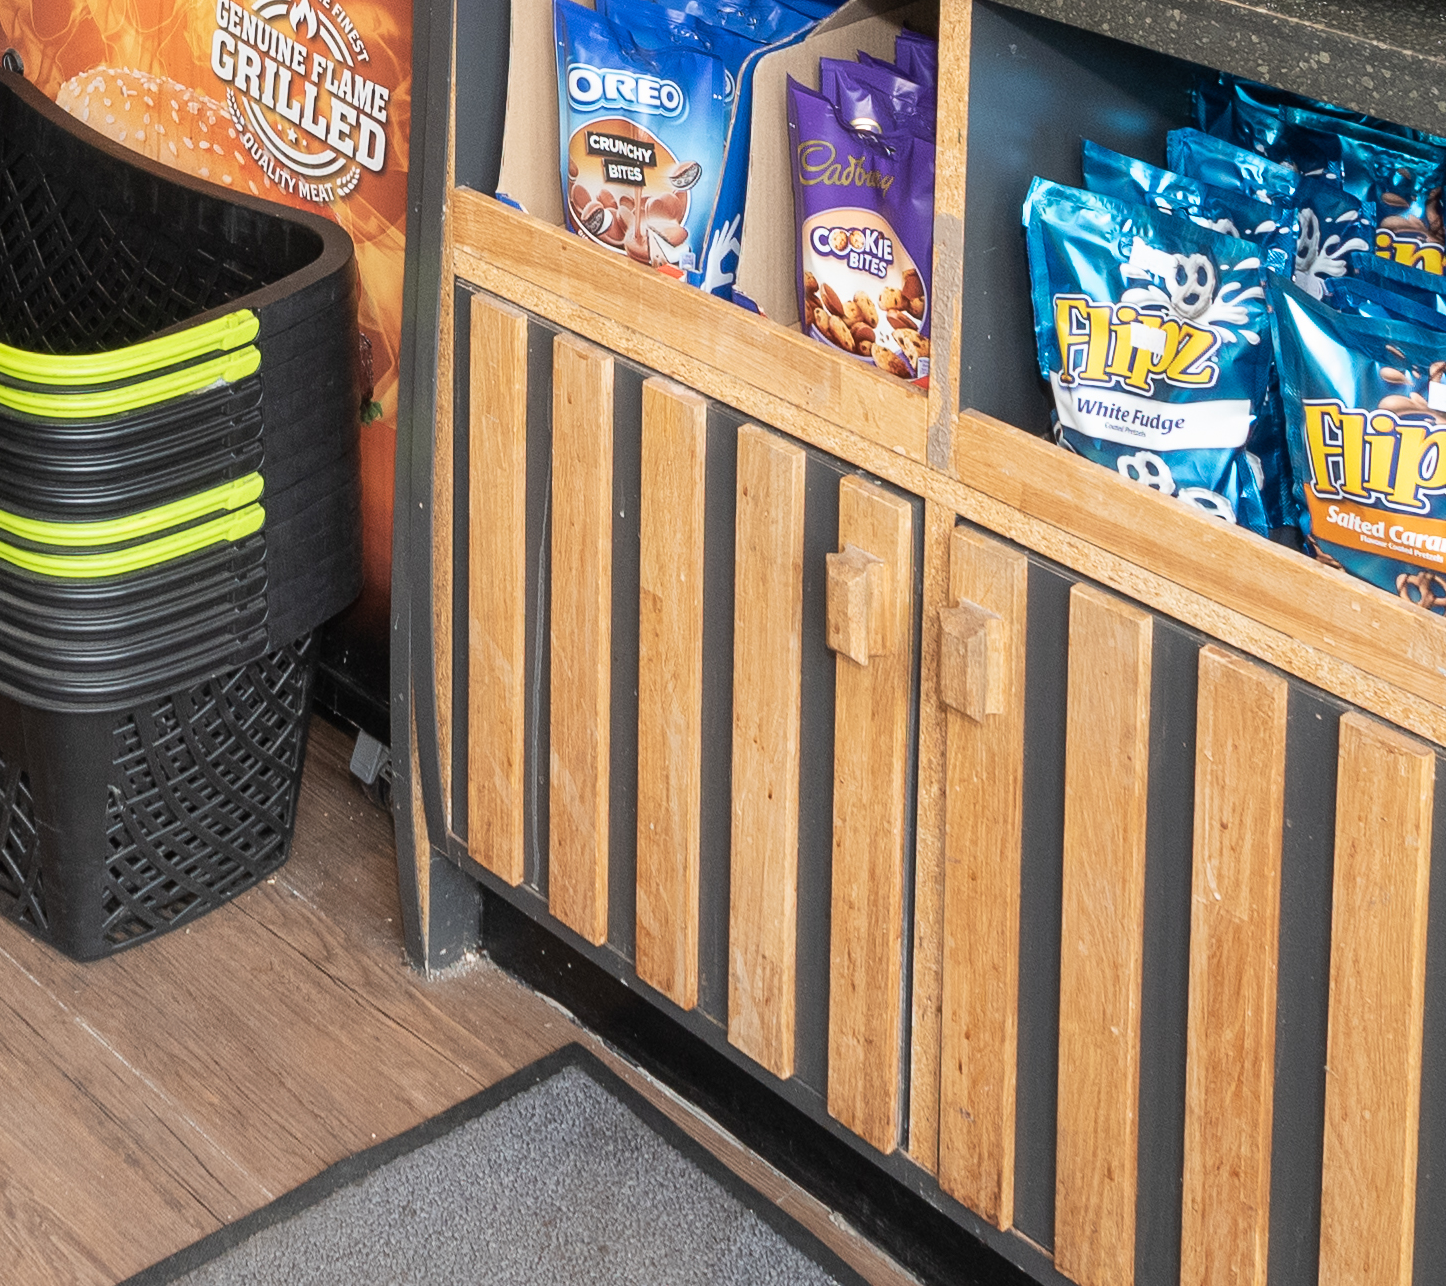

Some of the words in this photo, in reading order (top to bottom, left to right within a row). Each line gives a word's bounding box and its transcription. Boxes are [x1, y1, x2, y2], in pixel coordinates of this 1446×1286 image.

[331, 2, 371, 63] FINEST
[209, 27, 388, 174] GRILLED
[310, 52, 390, 125] FLAME
[568, 69, 681, 110] OREO
[242, 131, 297, 195] QUALITY
[297, 180, 336, 203] MEAT
[587, 132, 655, 166] CRUNCHY
[607, 162, 645, 184] BITES
[797, 139, 895, 199] Cadbury
[848, 252, 888, 279] BITES
[1053, 295, 1221, 389] Flipz
[1076, 395, 1127, 425] White
[1129, 405, 1185, 435] Fudge
[1325, 504, 1385, 541] Salted
